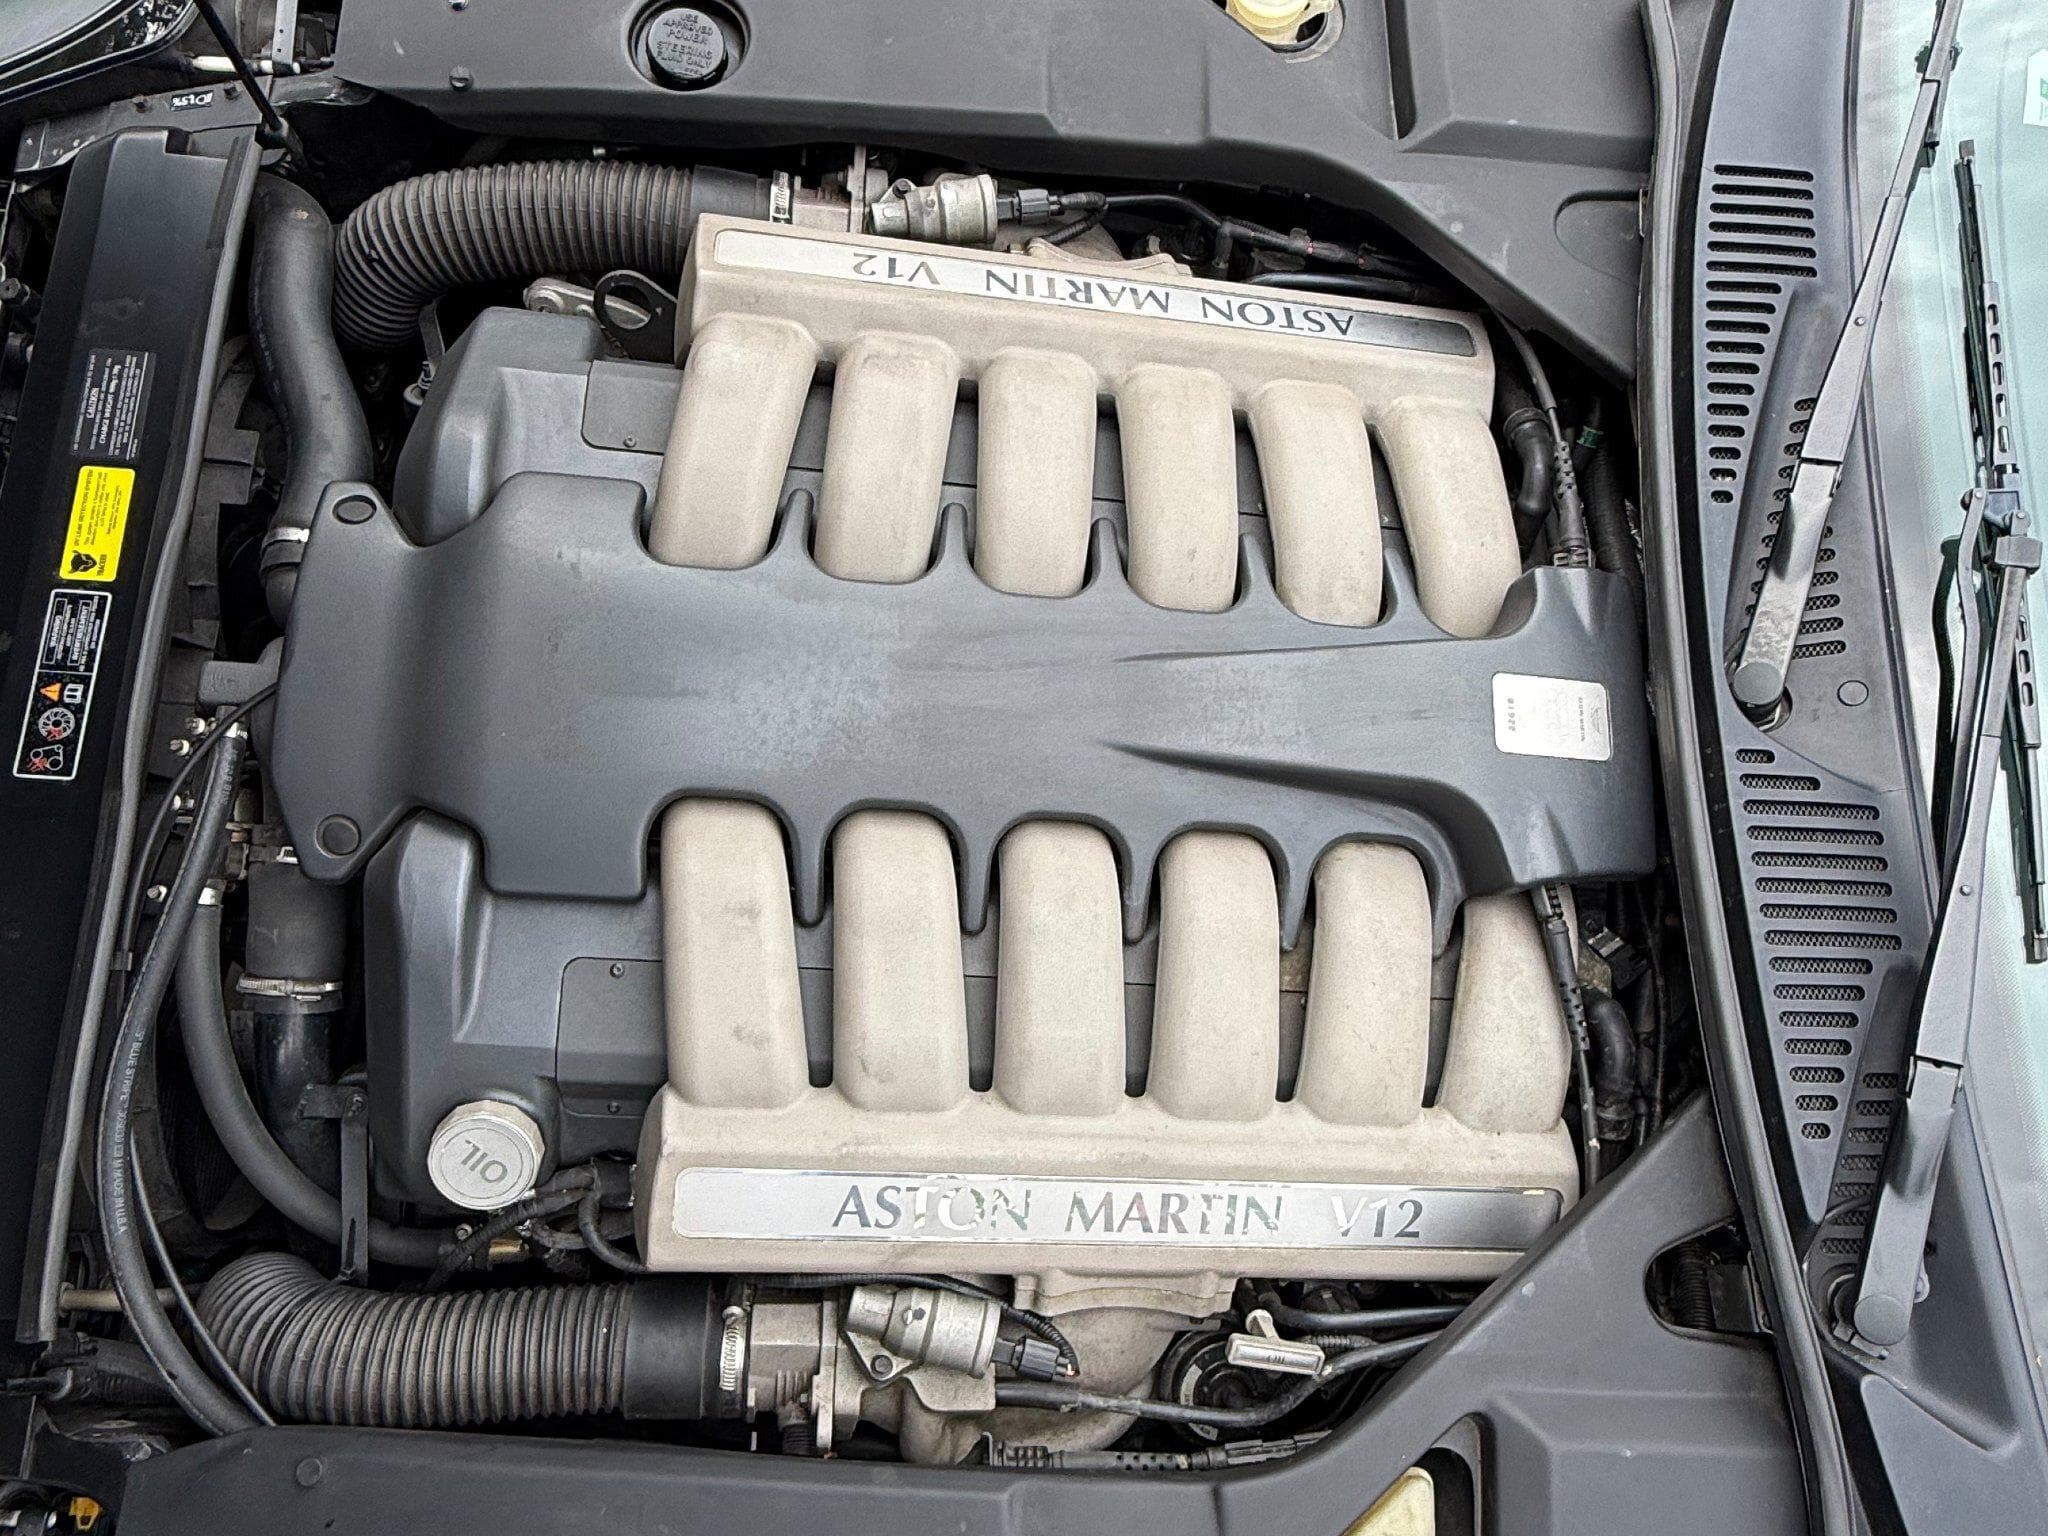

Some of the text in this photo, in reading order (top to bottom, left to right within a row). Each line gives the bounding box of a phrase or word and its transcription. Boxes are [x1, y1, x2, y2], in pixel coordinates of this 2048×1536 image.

[657, 40, 712, 60] STEERING
[852, 252, 1353, 335] ASTON MARTIN V12
[461, 1140, 508, 1183] OIL
[832, 1184, 1424, 1239] ASTON MARTIN V12
